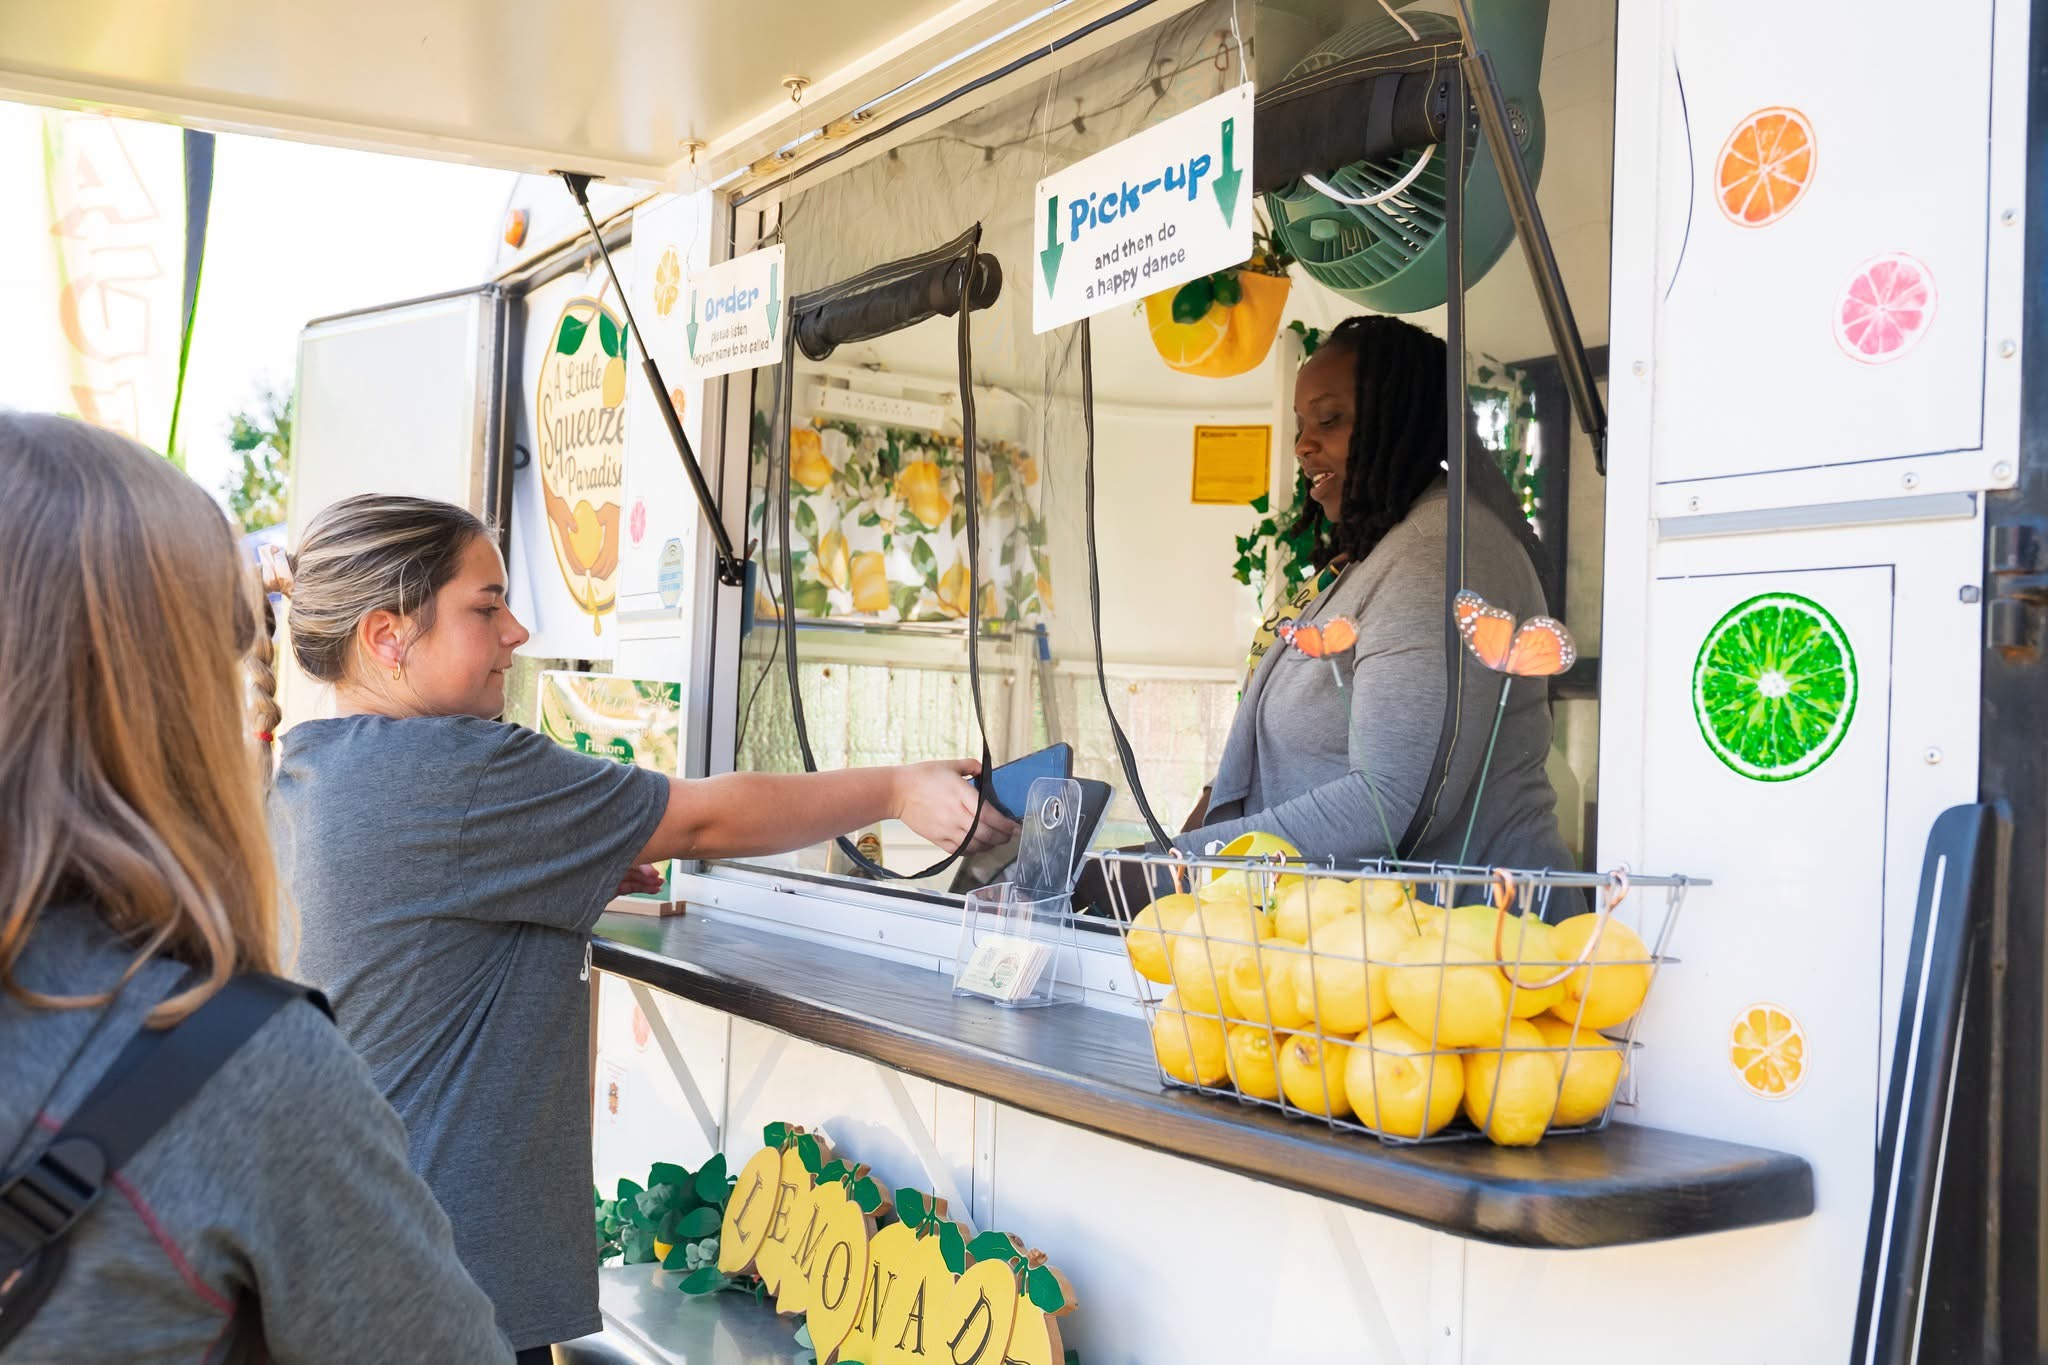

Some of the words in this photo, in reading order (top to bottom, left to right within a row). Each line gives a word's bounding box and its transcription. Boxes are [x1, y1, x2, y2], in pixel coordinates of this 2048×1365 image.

[1068, 153, 1212, 242] Pick-up
[1094, 243, 1119, 271] and
[1121, 232, 1154, 258] then
[1158, 222, 1176, 242] do
[1085, 284, 1095, 300] a
[1097, 265, 1138, 296] happy
[1142, 247, 1186, 279] dance
[705, 285, 759, 322] Order
[749, 335, 769, 353] called
[554, 361, 562, 402] A
[565, 353, 602, 400] Little
[544, 393, 625, 478] Squeeze
[585, 738, 625, 755] Flavors
[733, 1170, 1031, 1365] LEMONAD
